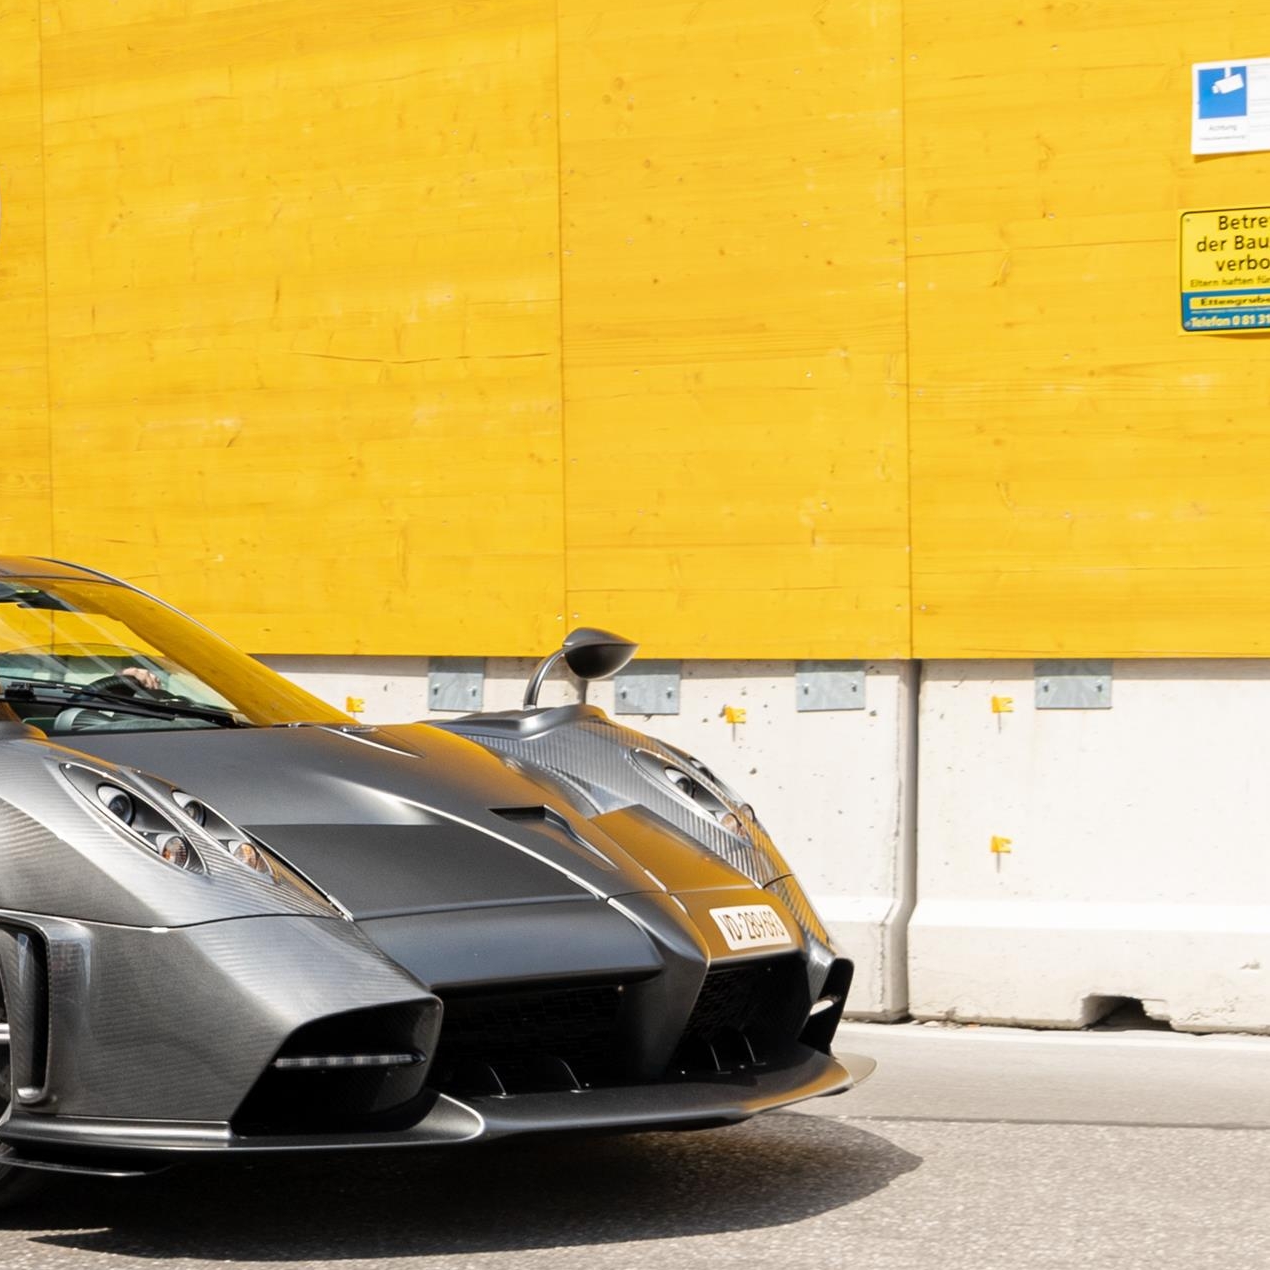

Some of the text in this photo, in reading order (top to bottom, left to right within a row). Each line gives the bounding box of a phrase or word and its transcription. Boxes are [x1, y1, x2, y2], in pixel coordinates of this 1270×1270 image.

[1196, 234, 1270, 253] der Bau
[1215, 254, 1270, 272] verbo
[1190, 279, 1219, 288] Eltern
[1222, 276, 1253, 286] haften
[1190, 315, 1231, 327] Telefon
